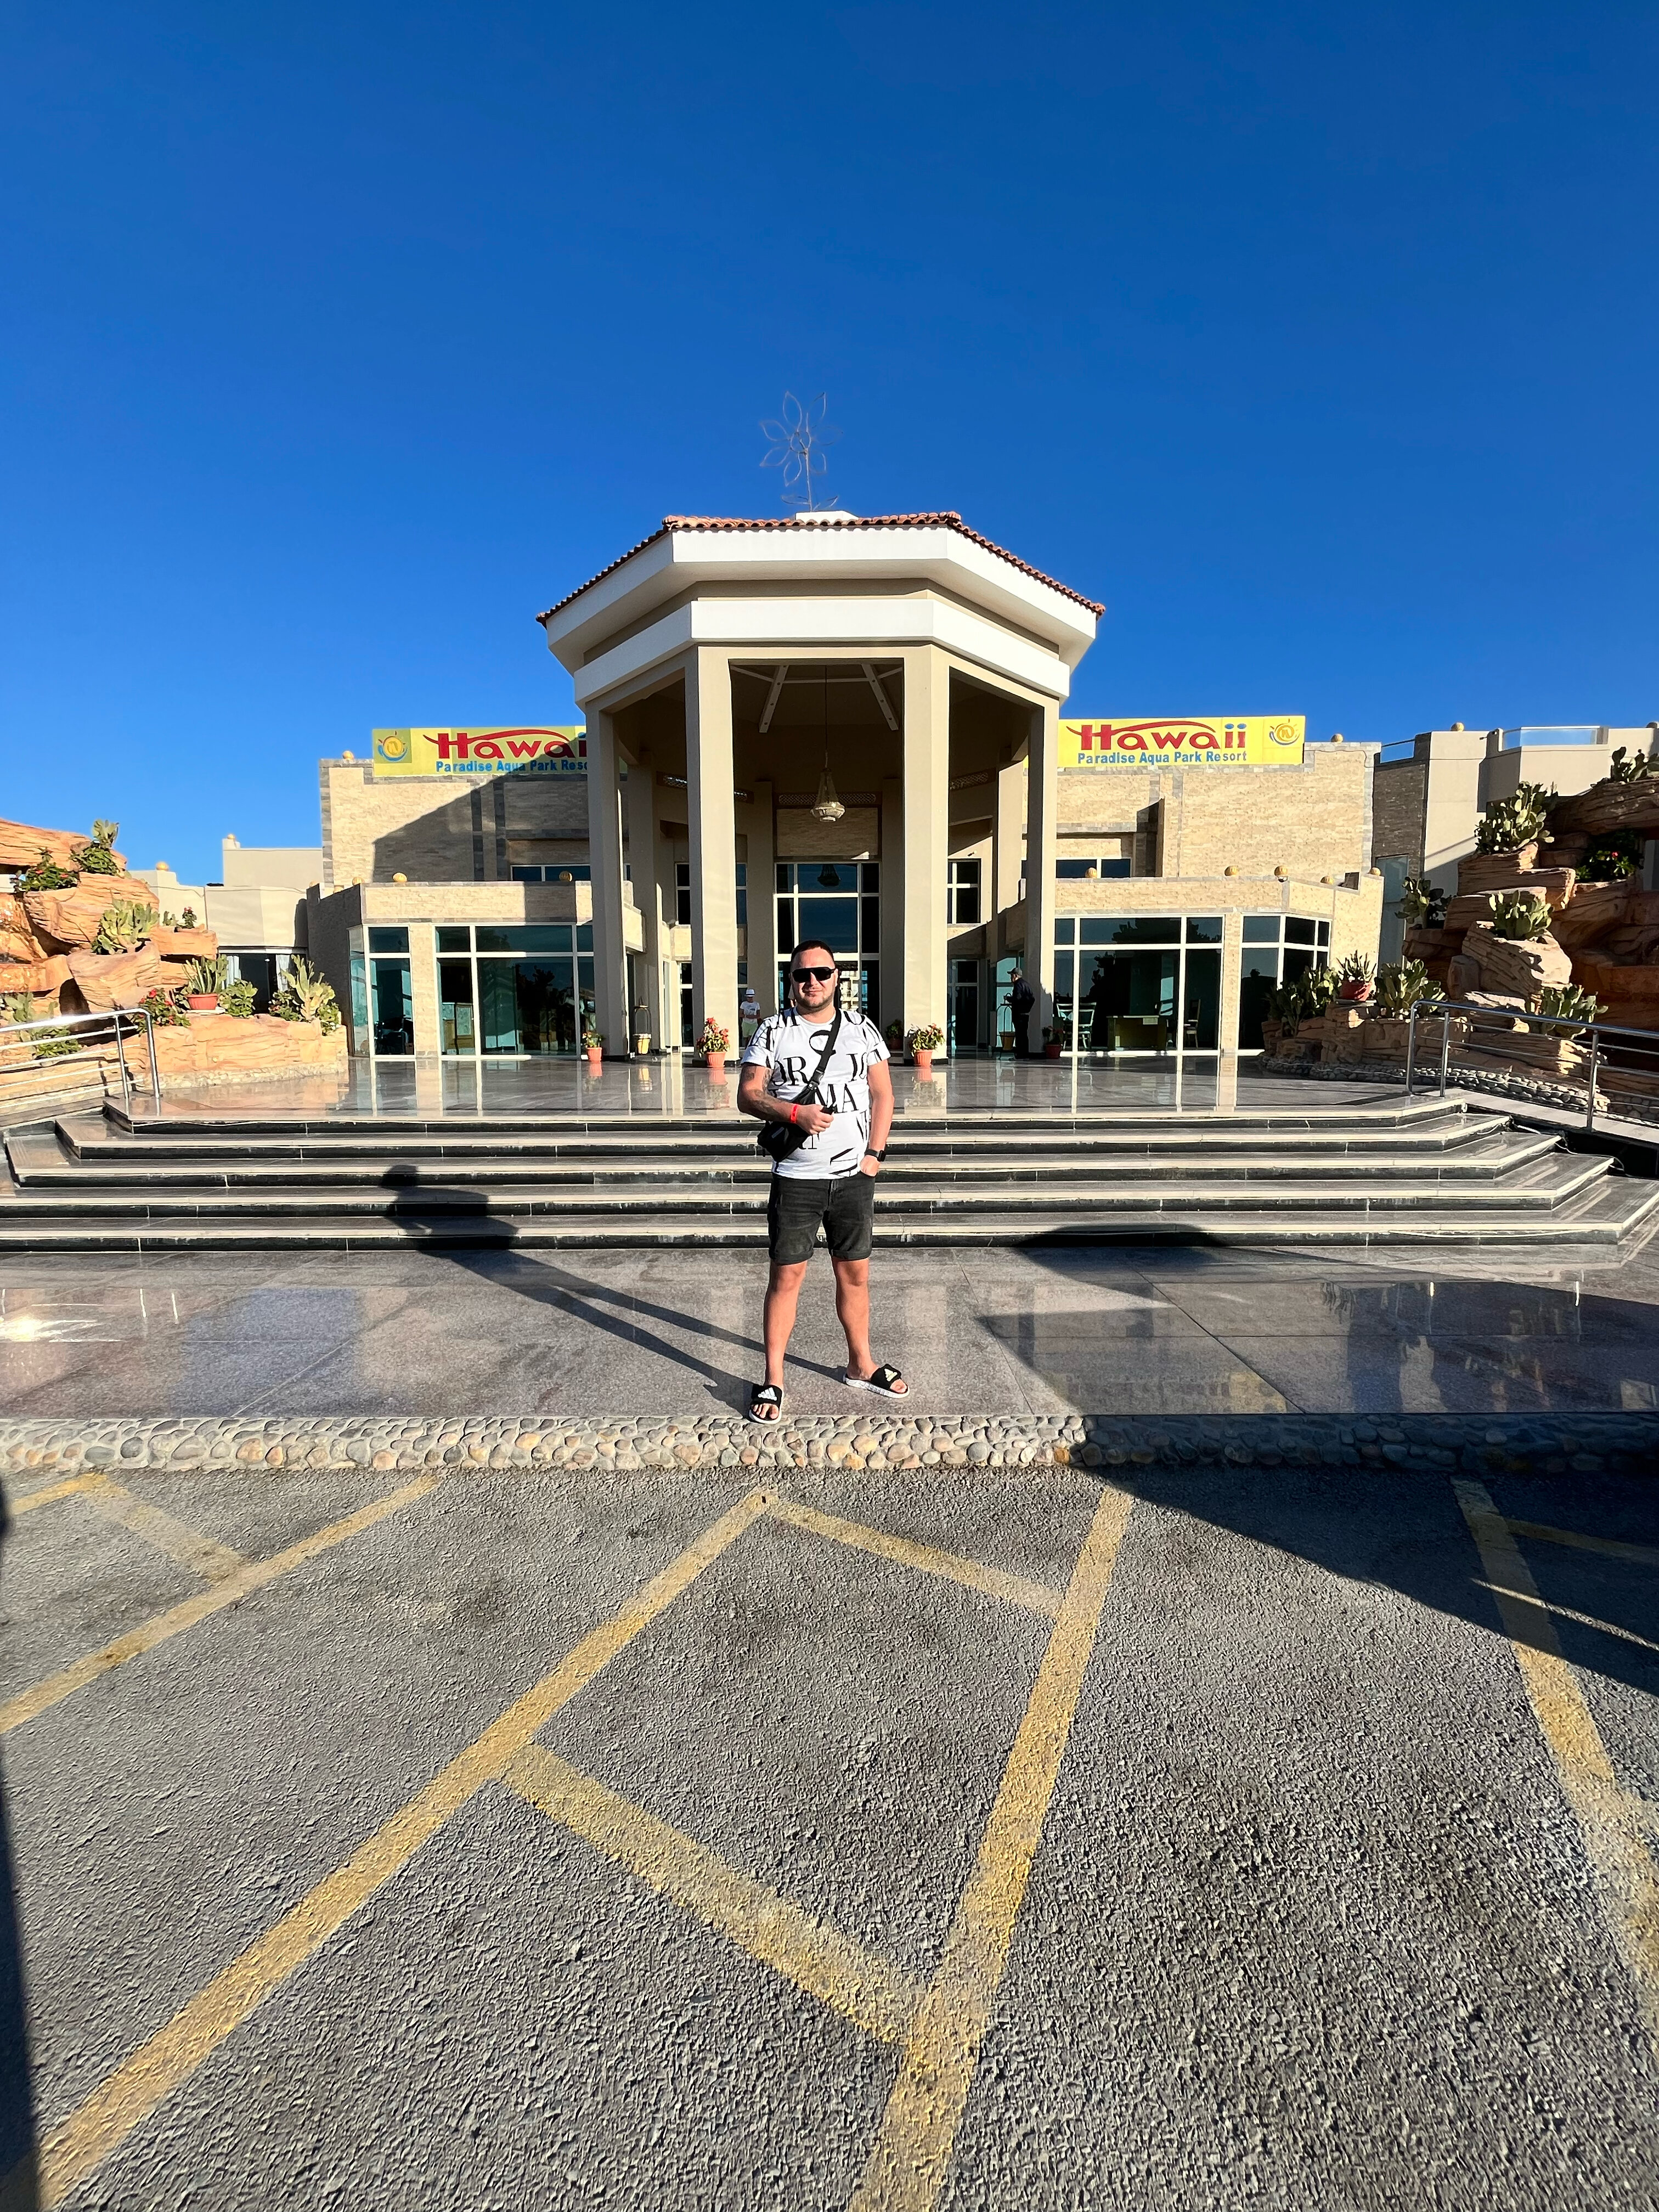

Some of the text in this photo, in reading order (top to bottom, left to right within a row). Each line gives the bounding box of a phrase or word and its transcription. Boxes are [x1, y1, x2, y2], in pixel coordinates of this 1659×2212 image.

[1066, 721, 1246, 750] Hawaii
[1078, 751, 1247, 765] Paradise Aqua Park Resort
[436, 761, 492, 772] Paradise
[496, 761, 526, 774] Aqua
[530, 760, 557, 771] Park
